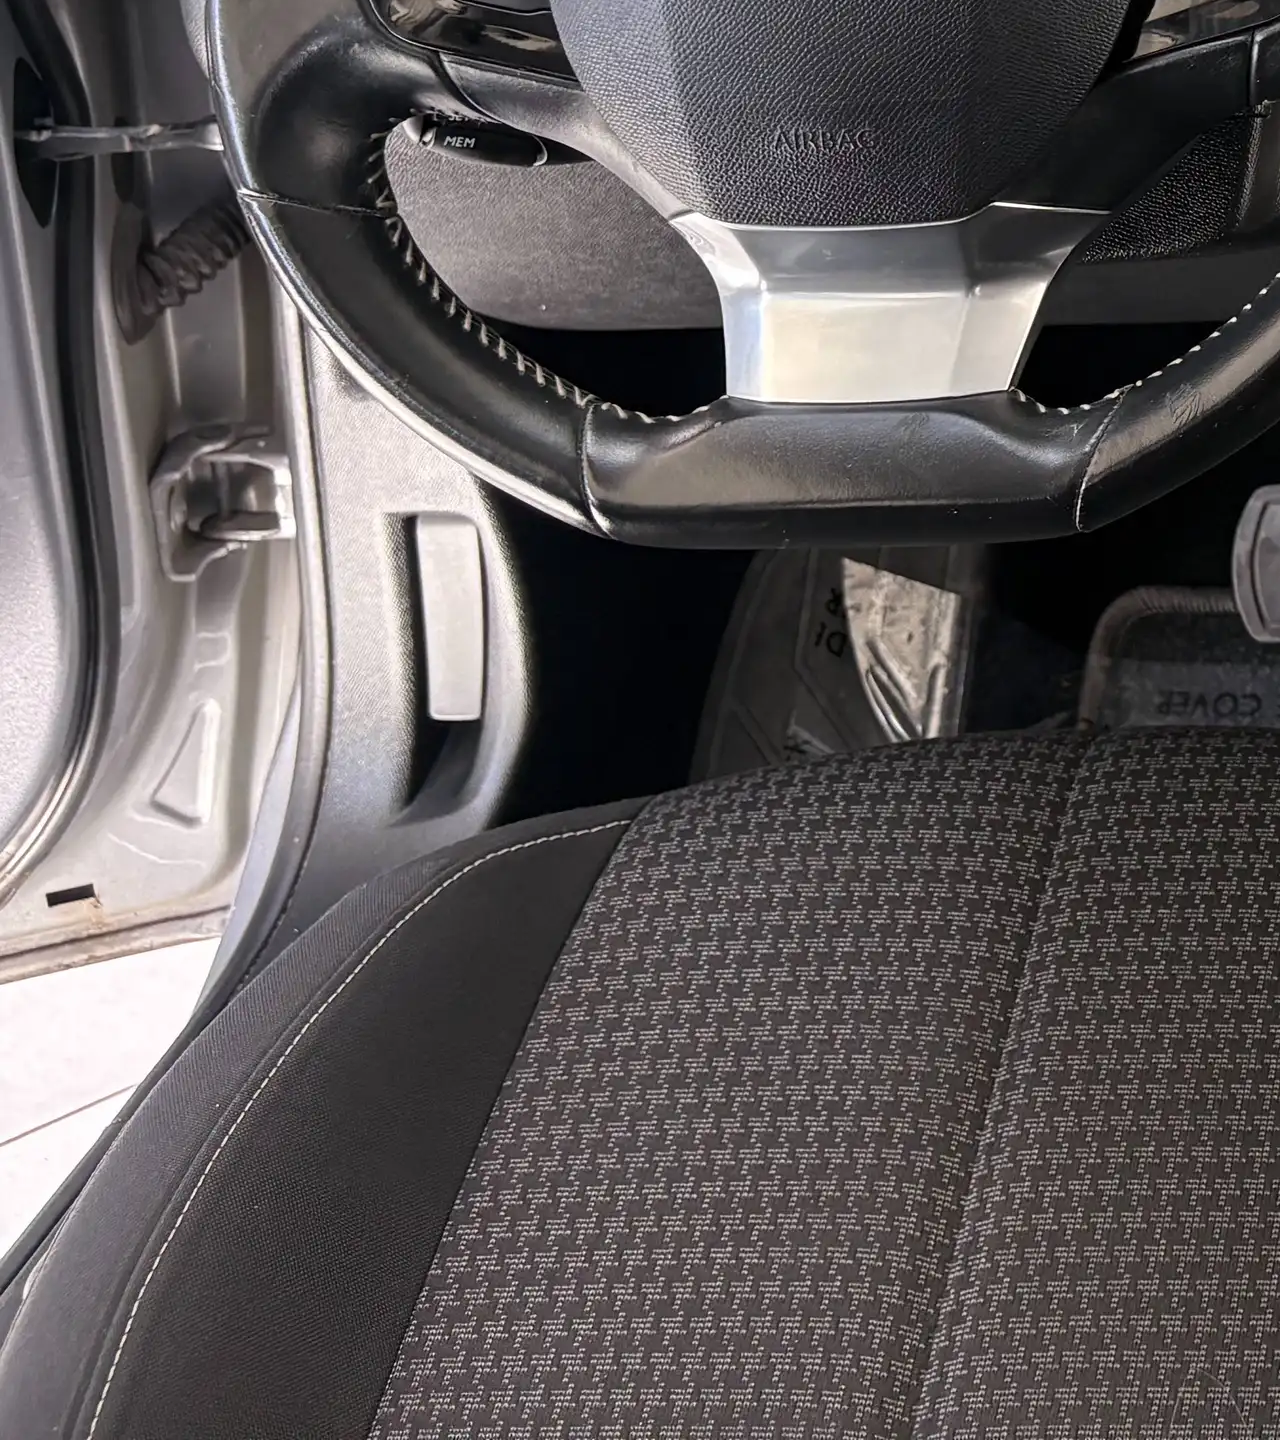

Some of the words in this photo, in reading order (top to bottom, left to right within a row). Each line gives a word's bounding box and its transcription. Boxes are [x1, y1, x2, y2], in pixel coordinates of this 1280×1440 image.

[443, 135, 476, 148] MEM
[773, 128, 875, 150] AIRBAG
[1157, 690, 1263, 718] COVER
